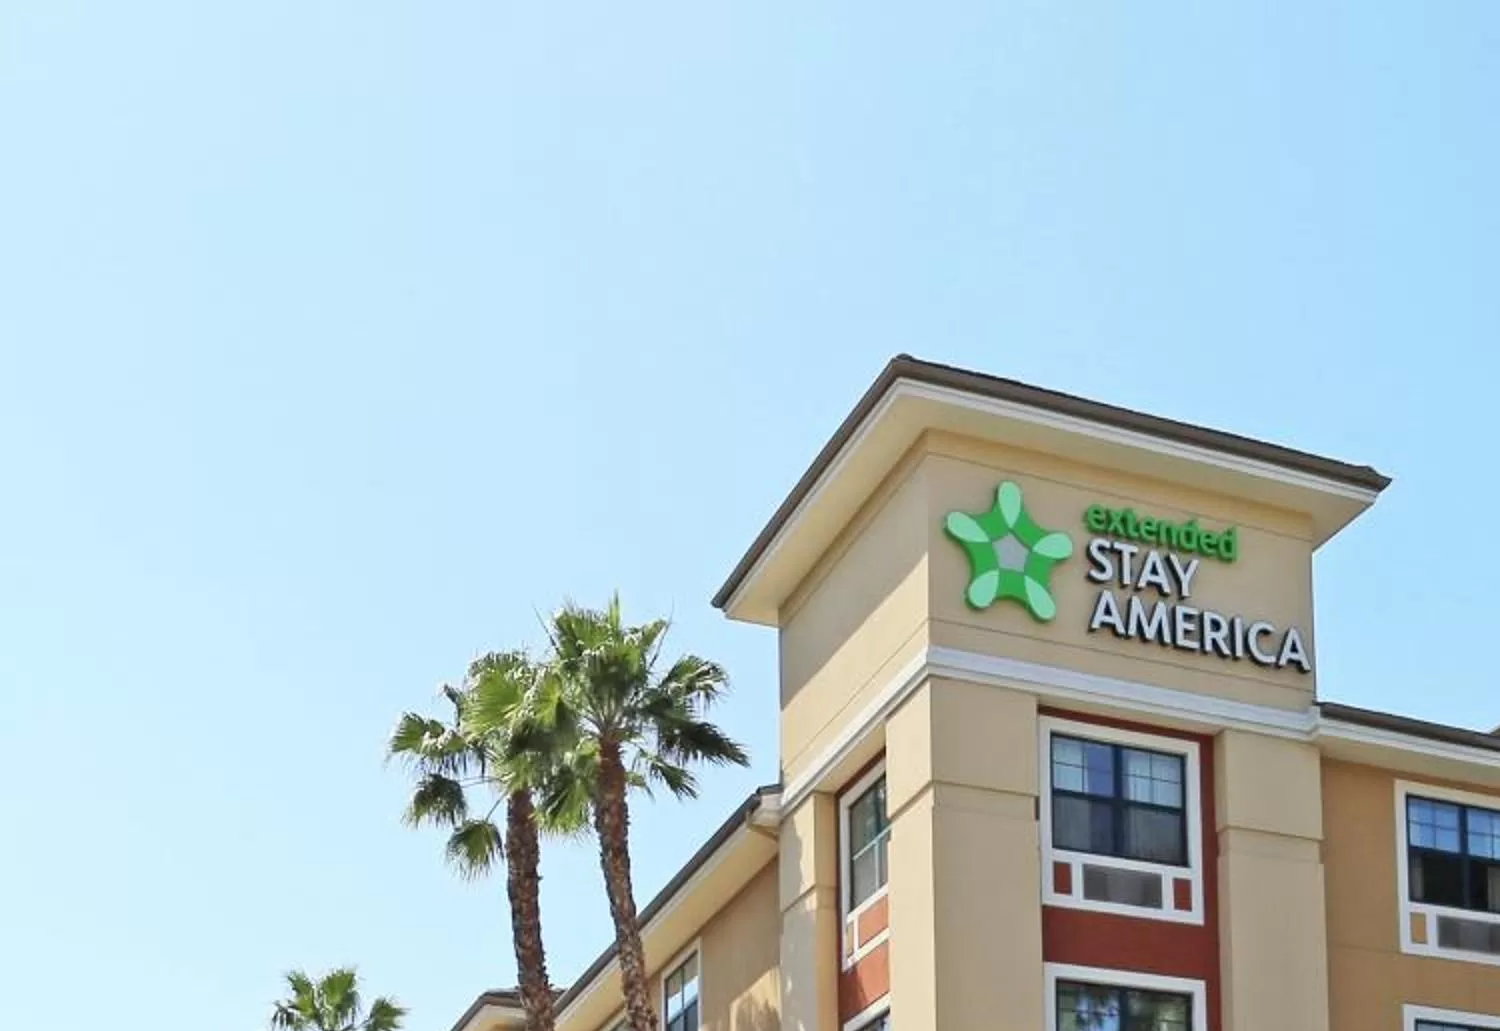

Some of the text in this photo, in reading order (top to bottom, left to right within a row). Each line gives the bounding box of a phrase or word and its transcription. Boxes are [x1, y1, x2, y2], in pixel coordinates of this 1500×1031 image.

[1086, 503, 1238, 561] extended
[1087, 538, 1200, 599] STAY
[1089, 589, 1311, 672] AMERICA
